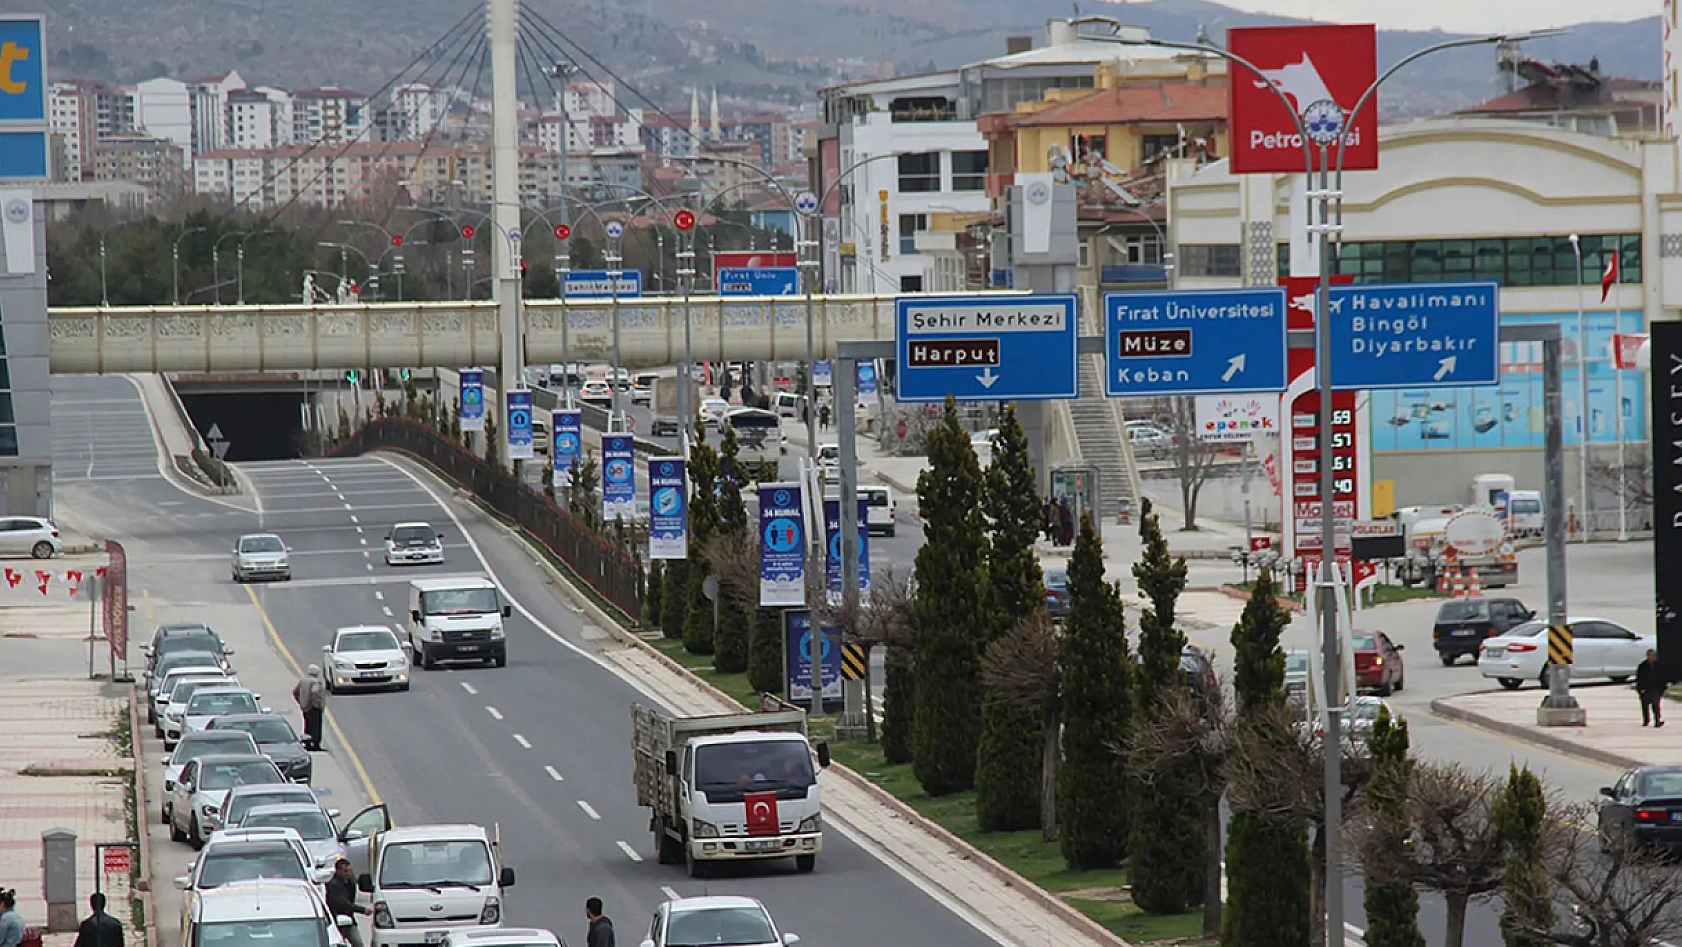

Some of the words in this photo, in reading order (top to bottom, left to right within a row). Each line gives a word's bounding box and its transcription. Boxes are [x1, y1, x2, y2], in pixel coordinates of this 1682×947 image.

[1117, 305, 1159, 321] Fırat
[1166, 301, 1274, 320] Üniversitesi
[1352, 293, 1486, 310] Havalimanı
[913, 311, 966, 330] Şehir
[976, 311, 1060, 327] Merkezi
[1352, 314, 1428, 334] Bingöl
[1124, 336, 1186, 352] Müze
[1352, 336, 1477, 358] Diyarbakır
[914, 345, 996, 364] Harput
[1118, 367, 1190, 383] Keban
[1295, 503, 1352, 516] Maet
